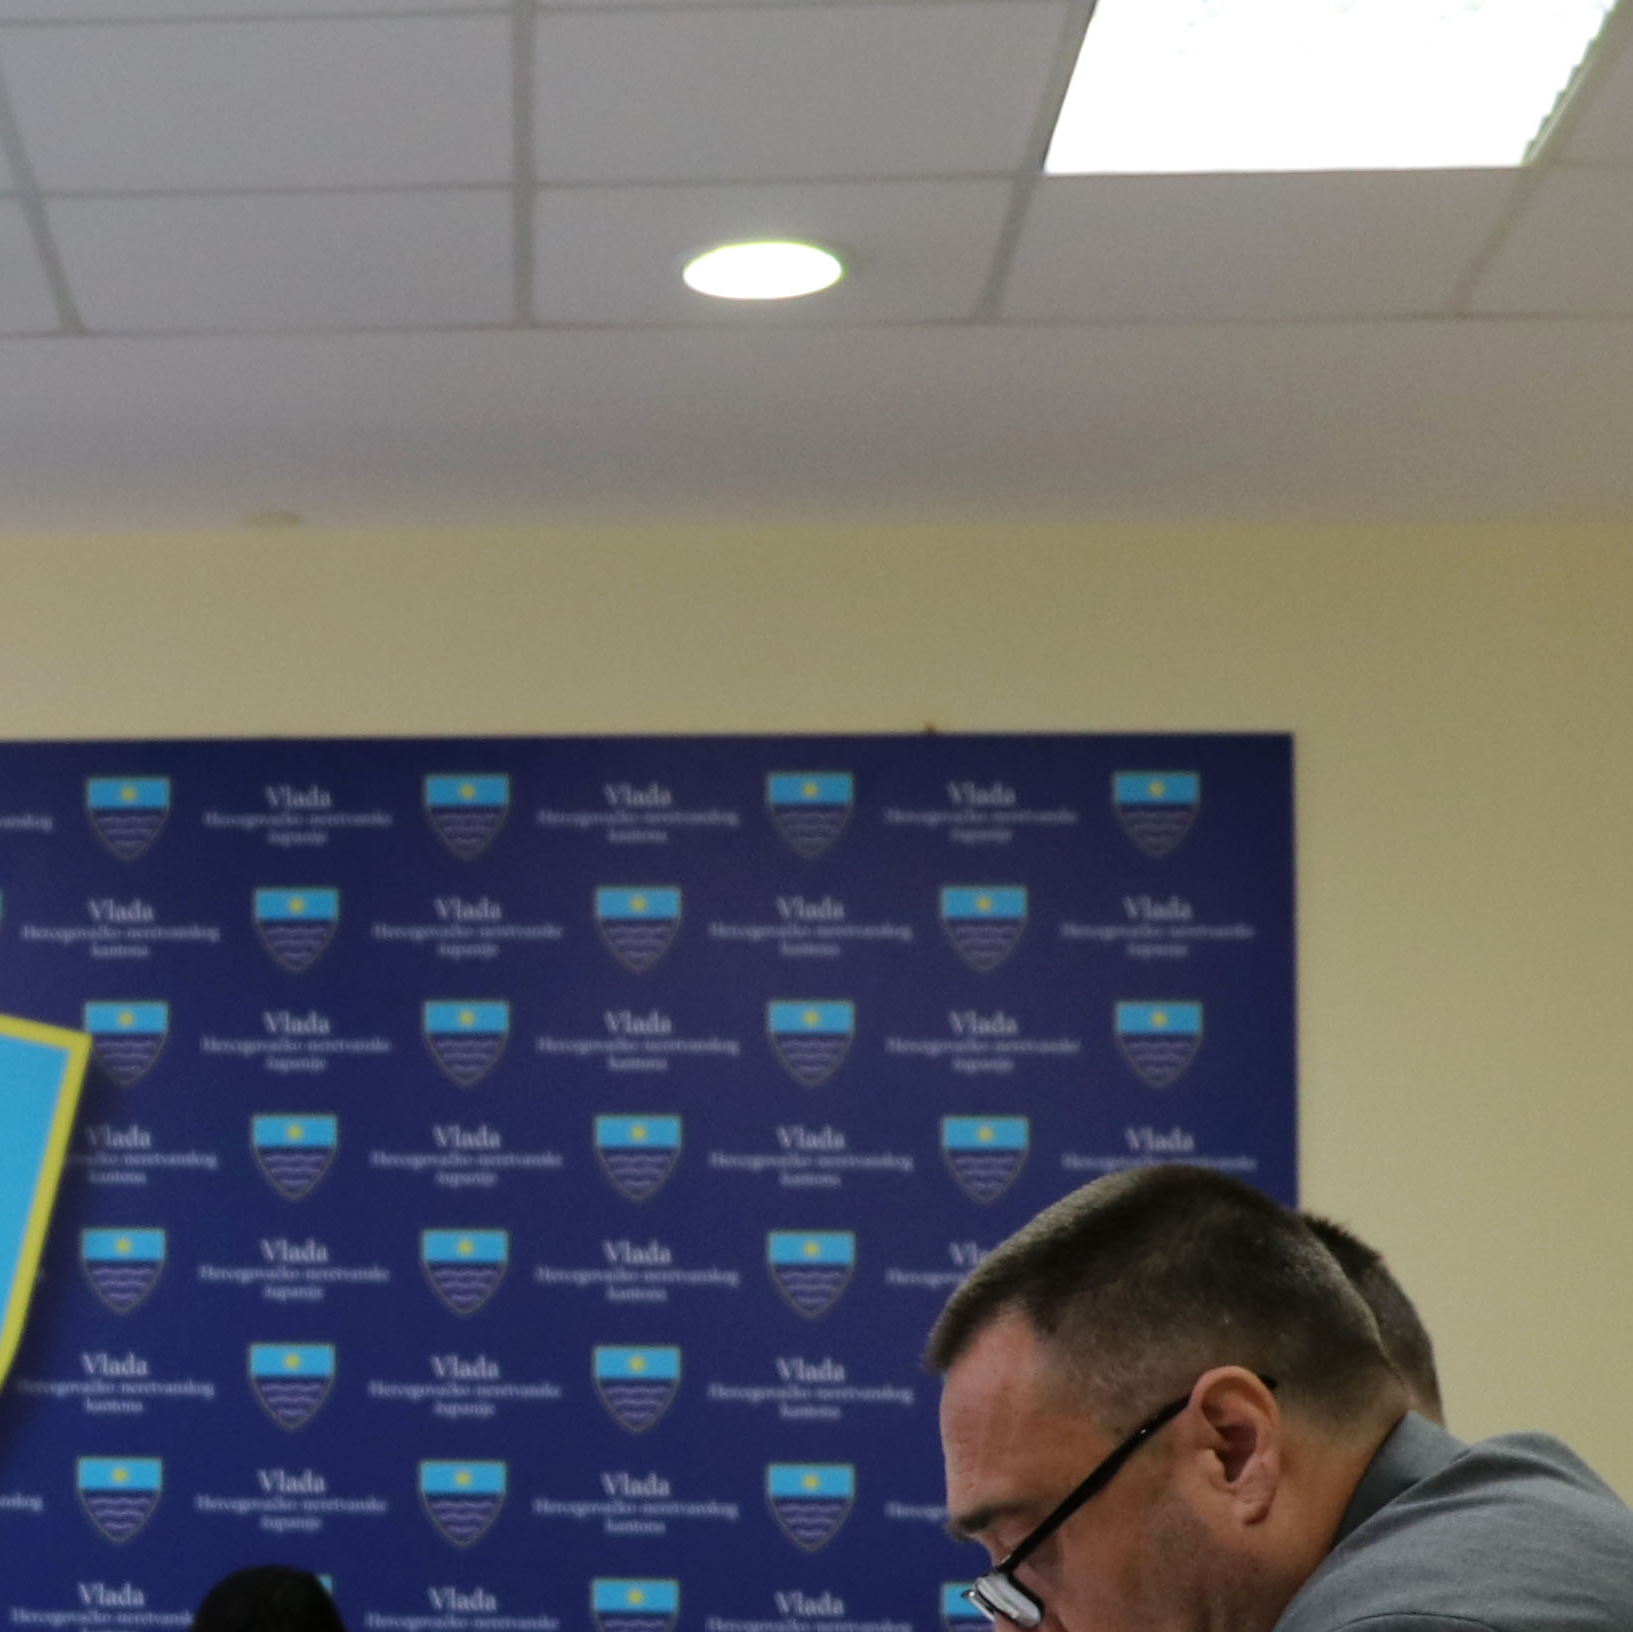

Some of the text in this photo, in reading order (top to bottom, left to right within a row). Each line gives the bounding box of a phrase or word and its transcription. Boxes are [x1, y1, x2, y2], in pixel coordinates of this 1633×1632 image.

[265, 785, 332, 811] Vlada
[604, 783, 673, 809] Vlada
[88, 899, 154, 924] Vlada
[435, 897, 502, 923] Vlada
[263, 1011, 330, 1037] Vlada
[604, 1010, 672, 1036] Vlada
[433, 1124, 501, 1151] Vlada
[261, 1238, 329, 1265] Vlada
[603, 1240, 672, 1266] Vlada
[81, 1352, 149, 1378] Vlada
[431, 1355, 499, 1382] Vlada
[258, 1469, 326, 1496] Vlada
[602, 1472, 671, 1498] Vlada
[78, 1582, 145, 1608] Vlada
[429, 1586, 497, 1612] Vlada
